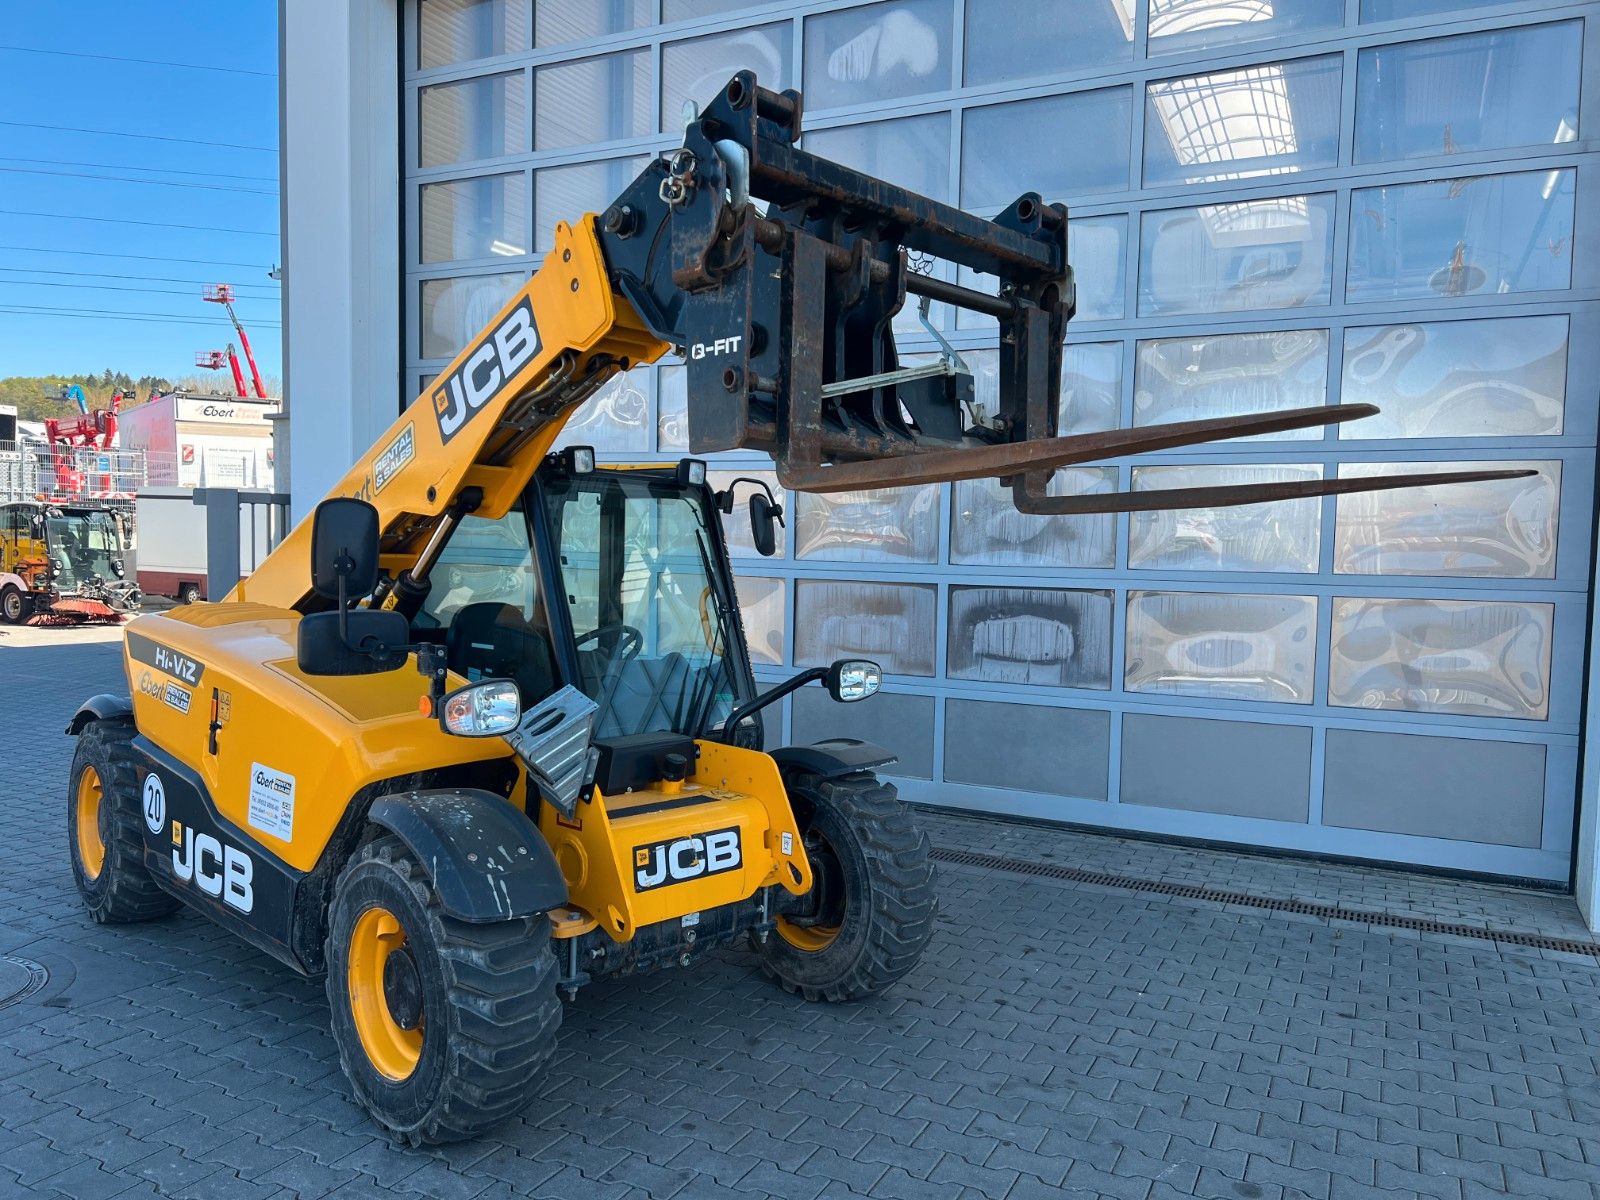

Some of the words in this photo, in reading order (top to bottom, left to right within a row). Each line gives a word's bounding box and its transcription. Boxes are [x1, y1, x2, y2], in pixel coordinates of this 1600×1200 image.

[691, 335, 742, 360] Q-FIT
[440, 307, 537, 435] JCB
[203, 405, 234, 418] Ebert
[375, 432, 412, 476] RENTAL
[383, 444, 412, 479] SALES
[167, 686, 189, 701] RENTAL
[257, 771, 275, 790] Ebert
[147, 785, 161, 823] 20
[172, 827, 254, 914] JCB
[636, 831, 741, 887] JCB
